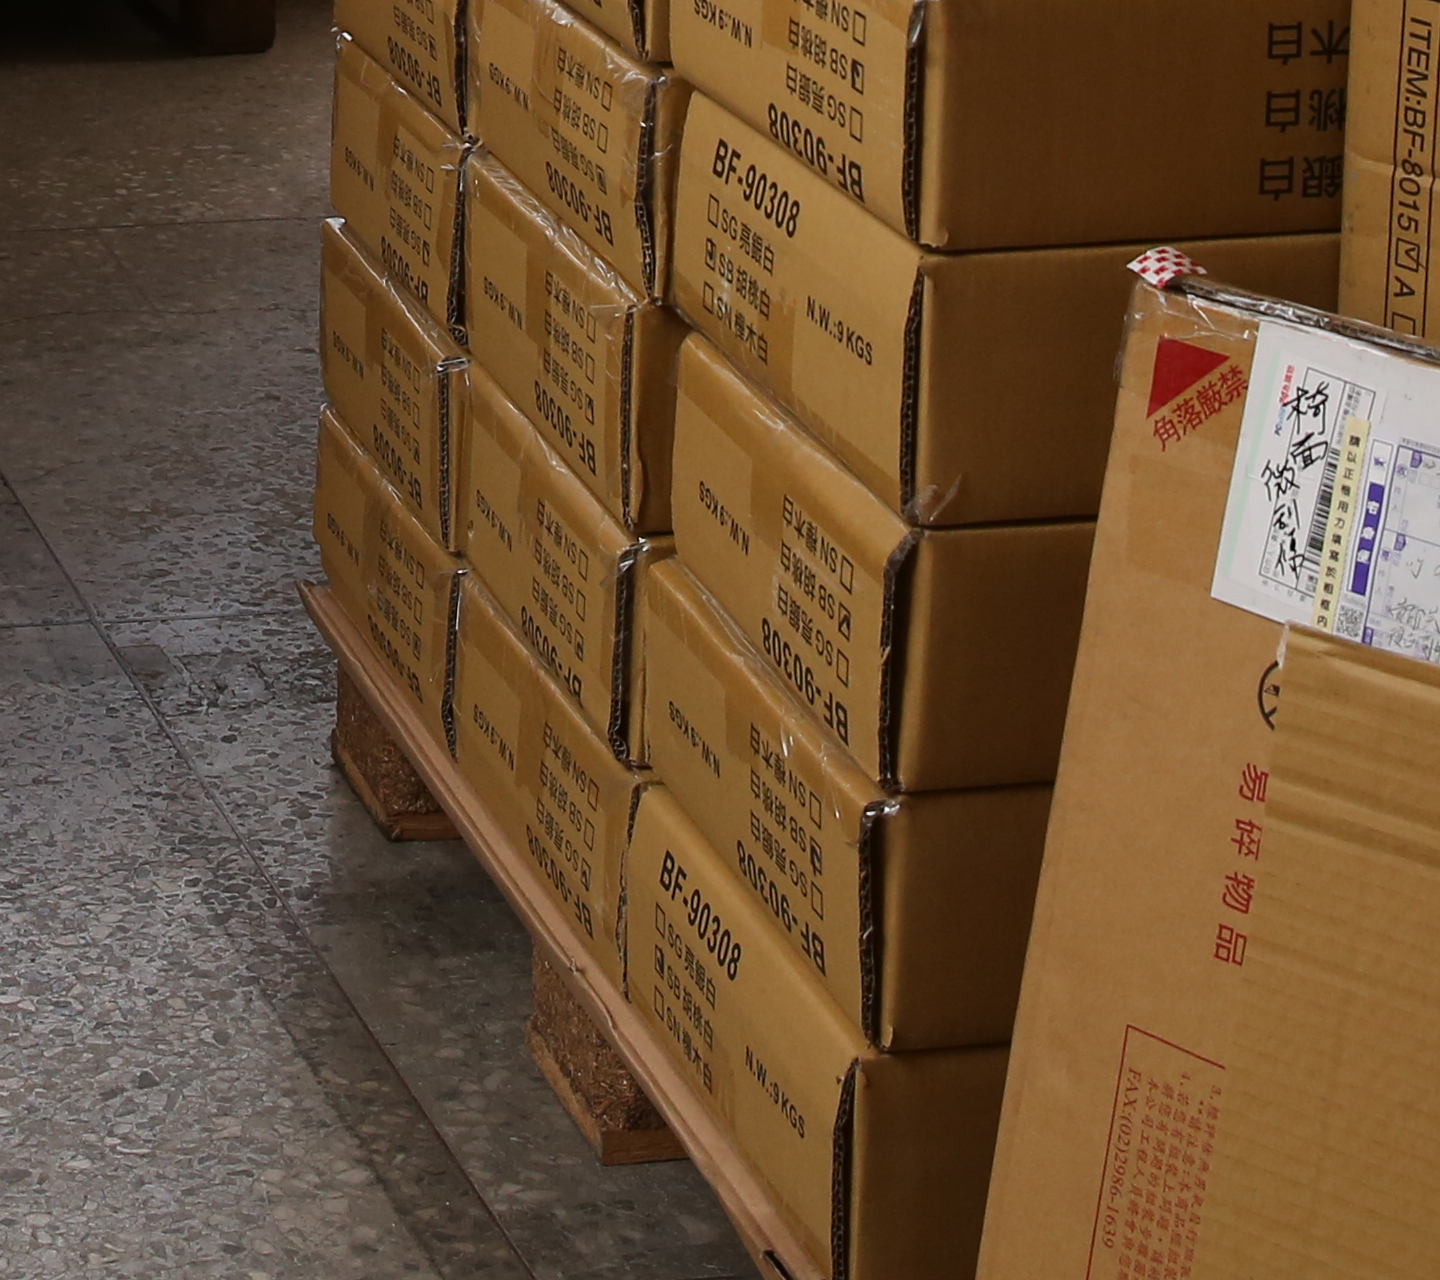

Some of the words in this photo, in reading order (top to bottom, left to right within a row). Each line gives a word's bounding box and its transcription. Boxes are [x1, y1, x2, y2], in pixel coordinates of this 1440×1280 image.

[1396, 14, 1434, 232] ITEM:BF-8015
[1392, 275, 1416, 299] A
[1212, 762, 1269, 967] 易碎物品
[1101, 1067, 1143, 1250] FAX:(02)2986-1639
